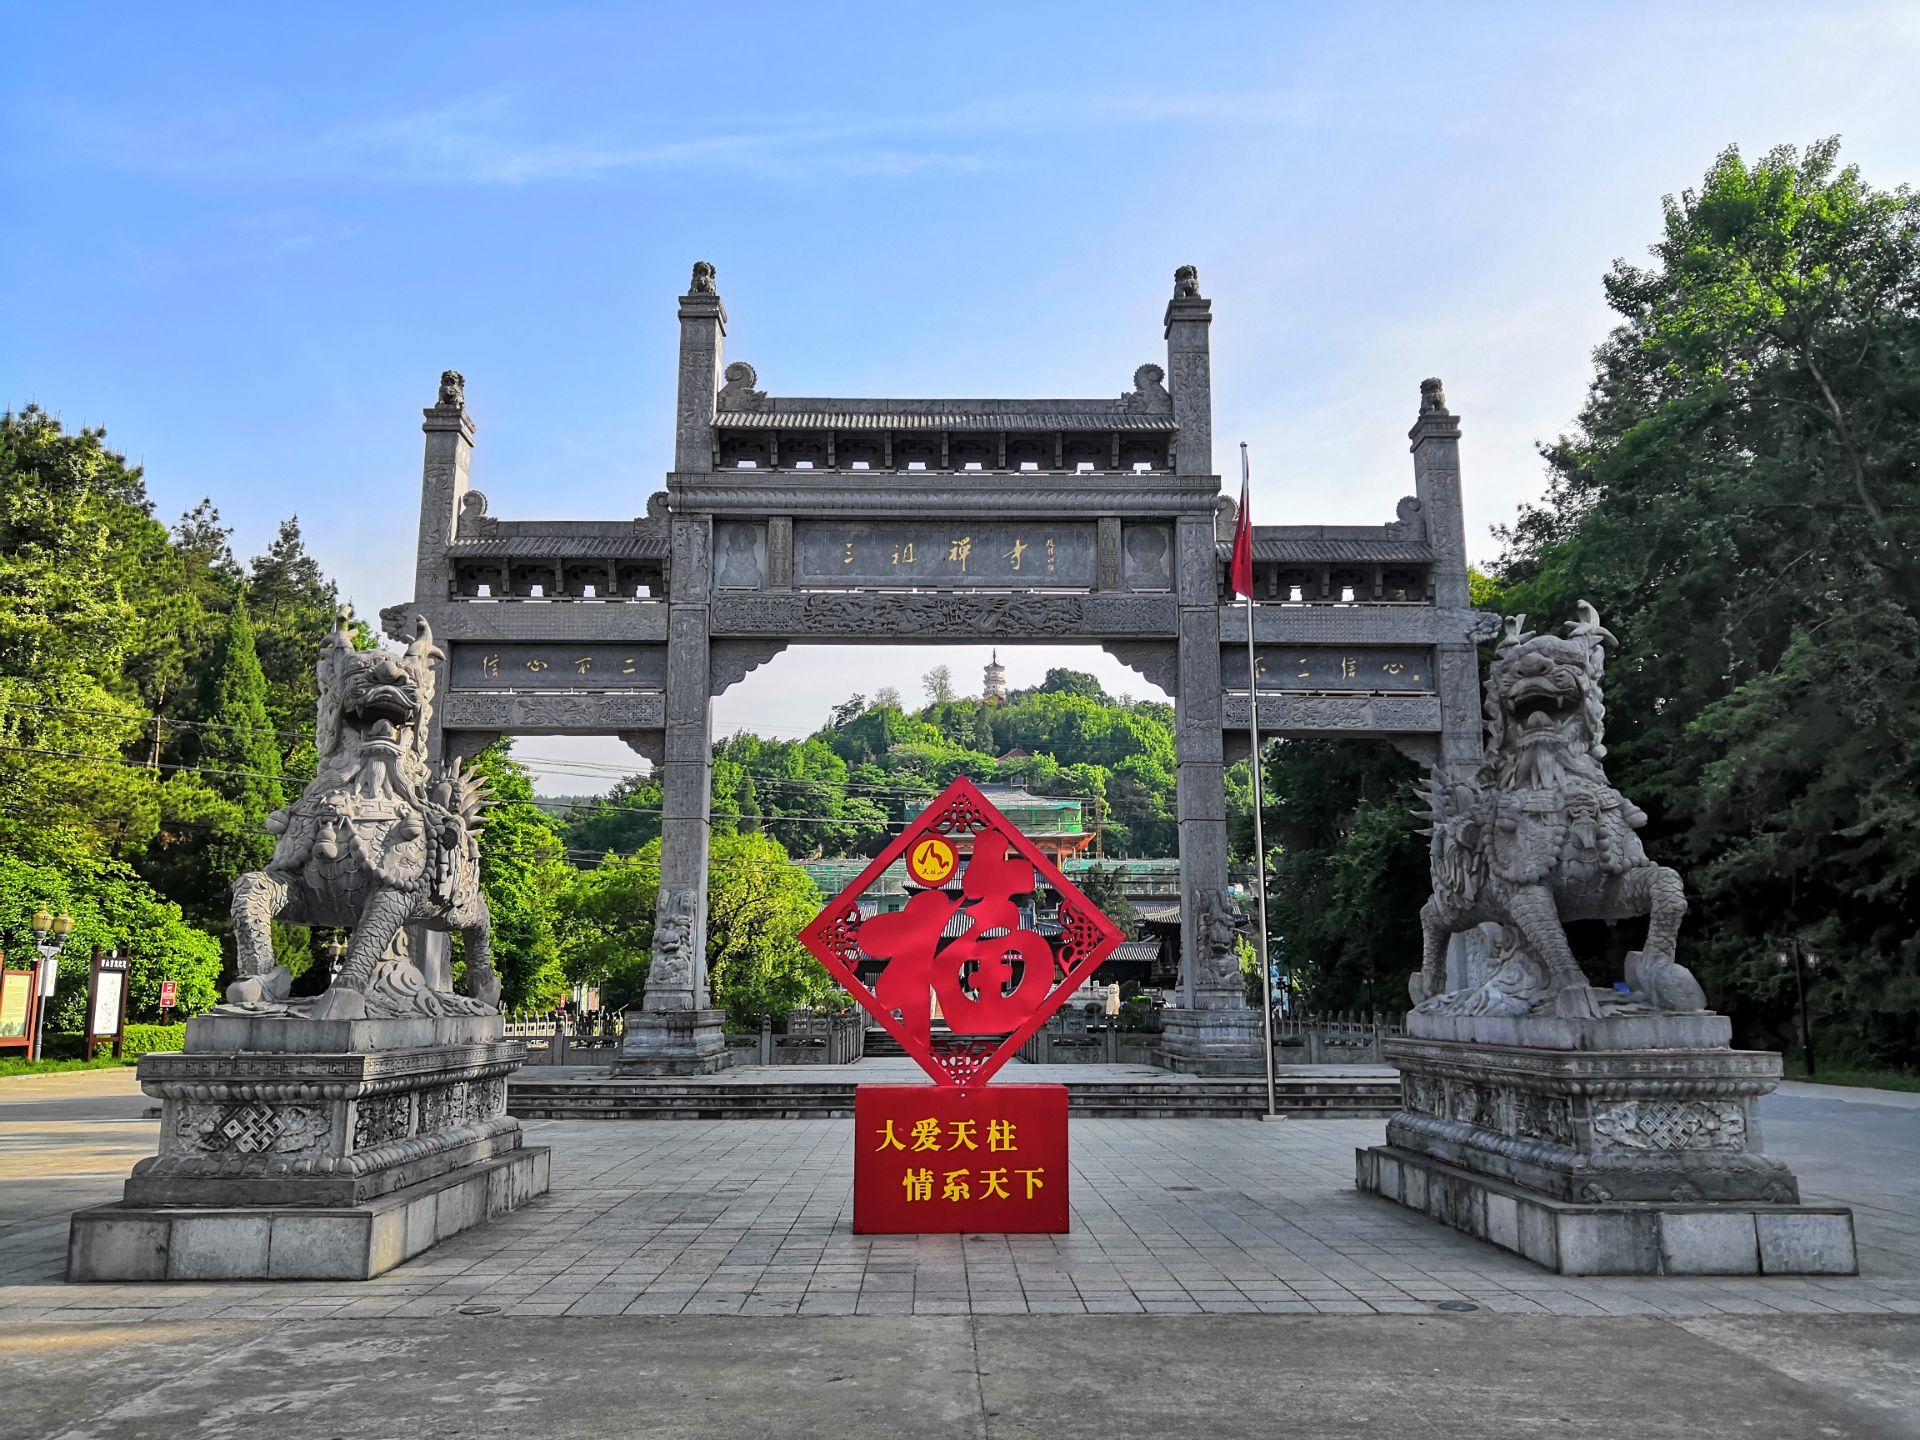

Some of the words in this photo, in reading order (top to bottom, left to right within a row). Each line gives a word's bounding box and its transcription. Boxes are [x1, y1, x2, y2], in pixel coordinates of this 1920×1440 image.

[857, 831, 1056, 1048] 福
[875, 1117, 1018, 1152] 大爱天柱
[902, 1167, 1045, 1202] 情系天下
